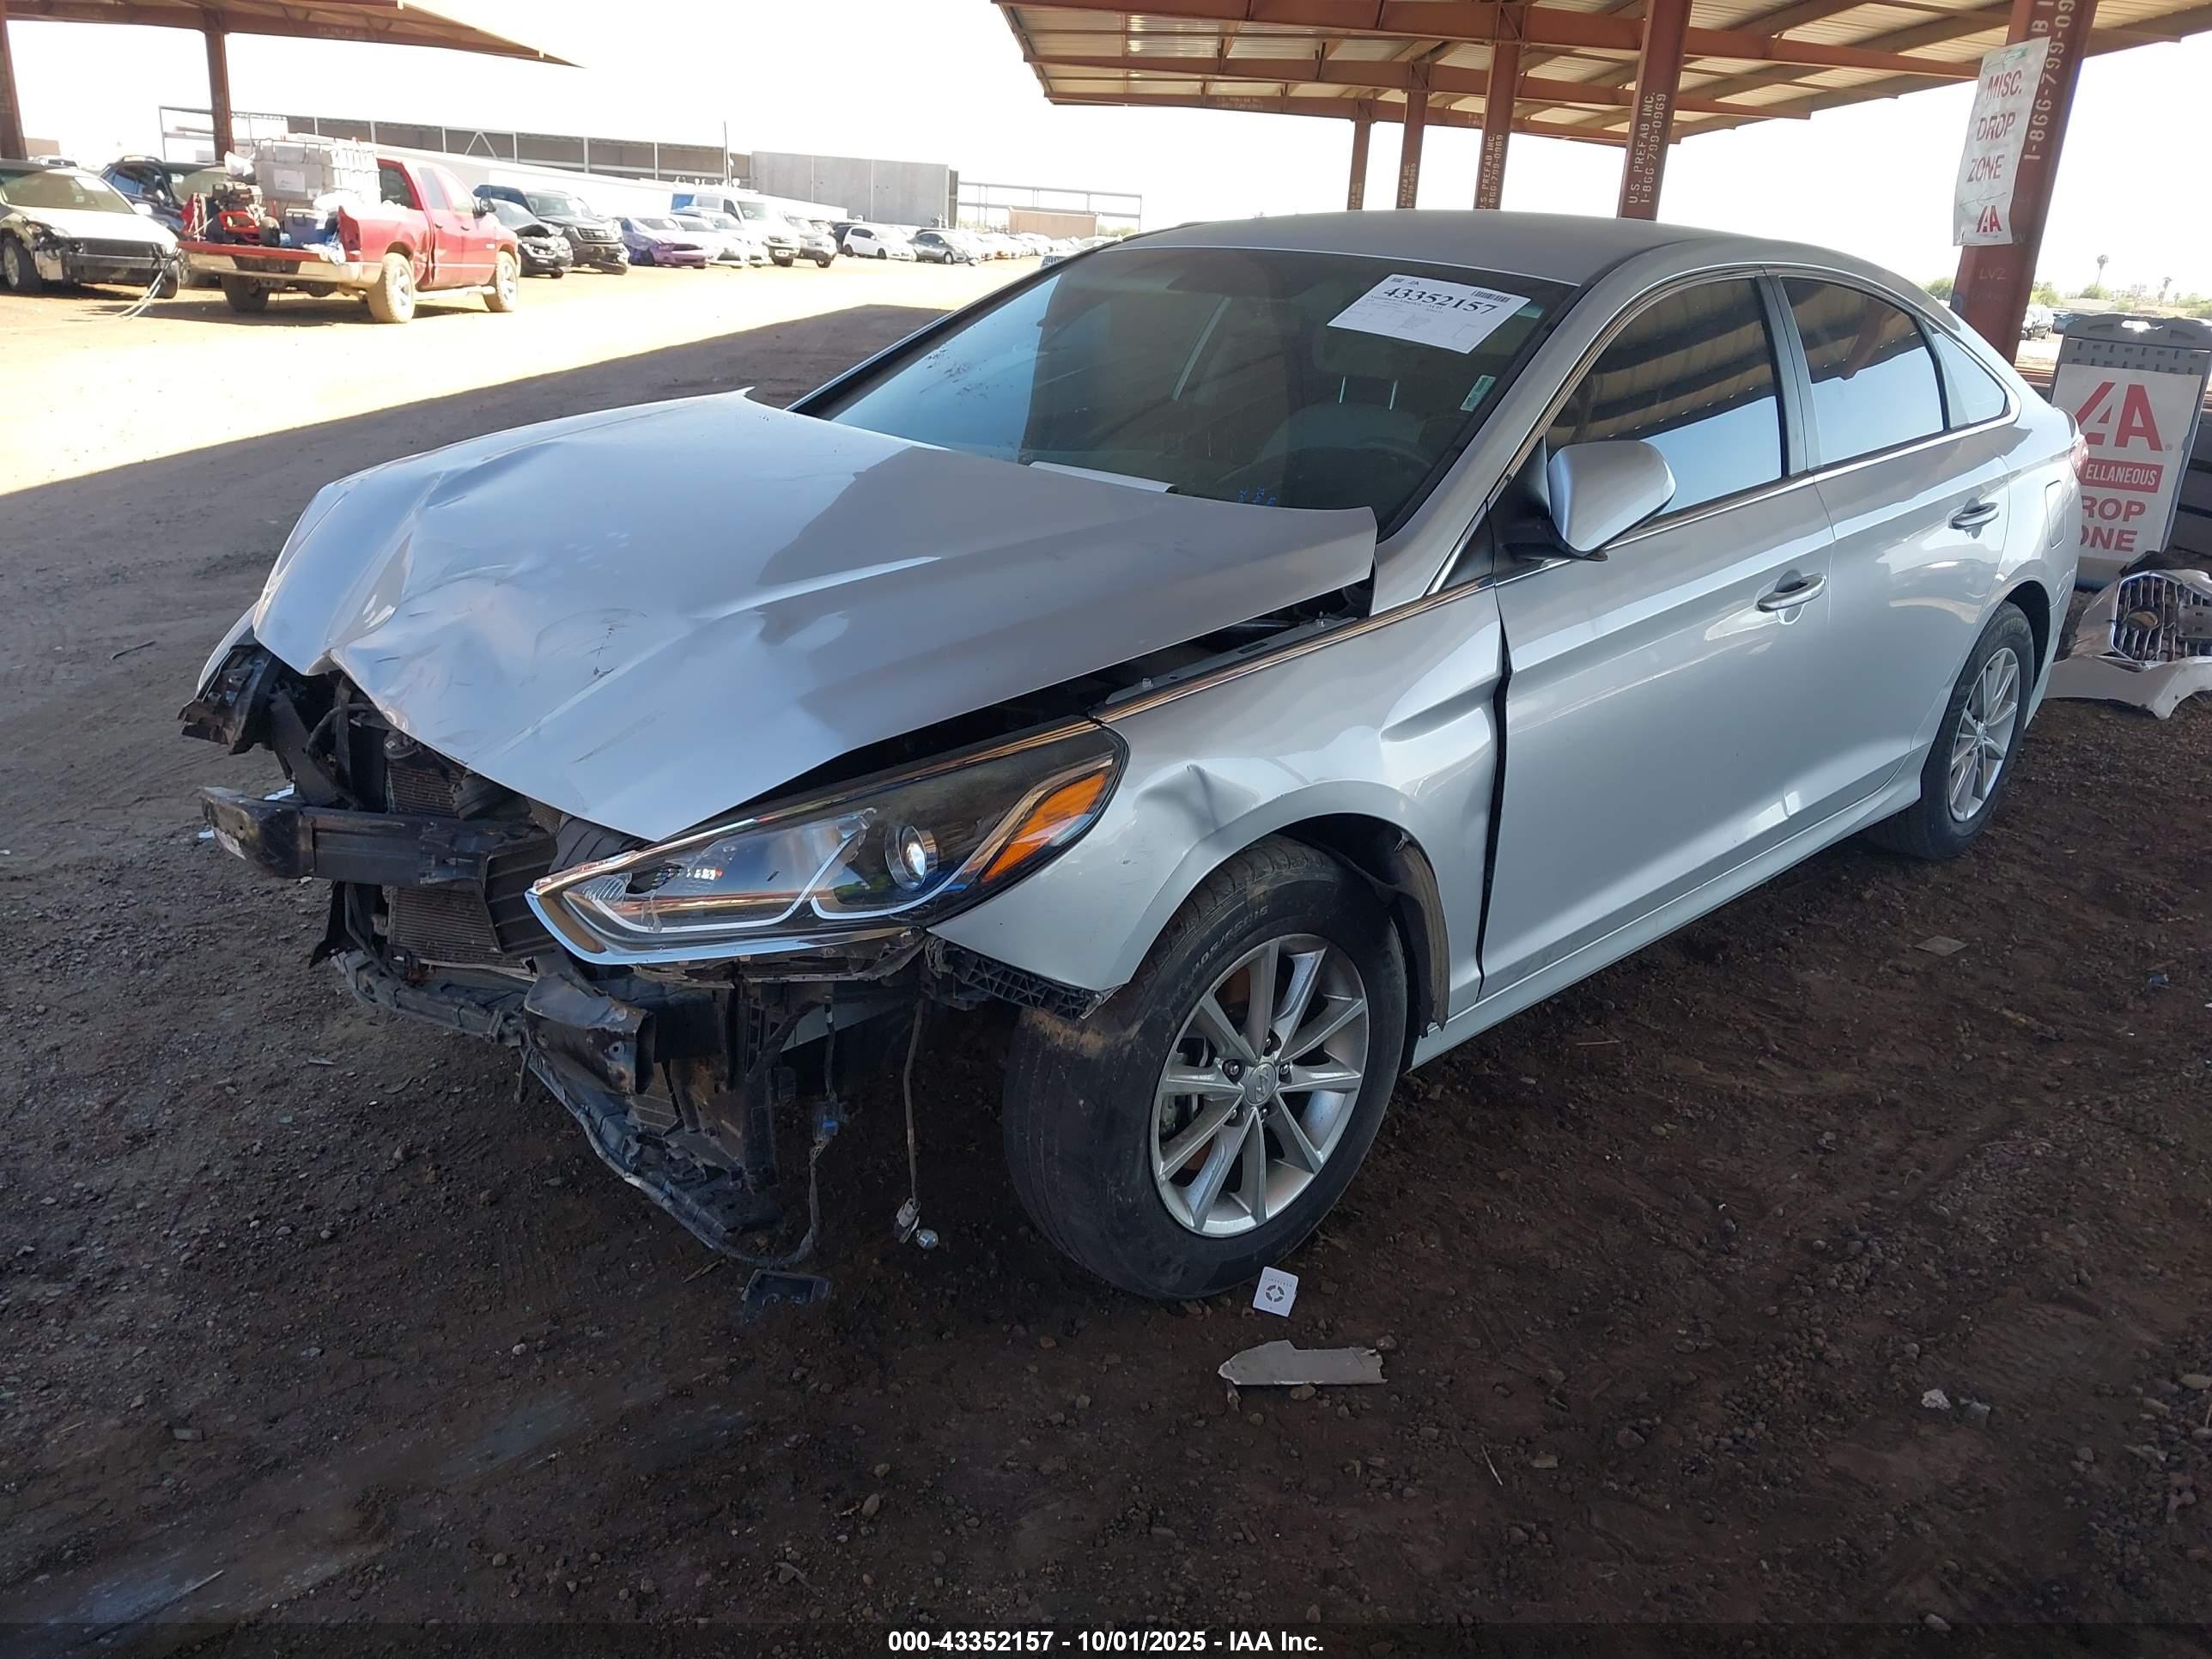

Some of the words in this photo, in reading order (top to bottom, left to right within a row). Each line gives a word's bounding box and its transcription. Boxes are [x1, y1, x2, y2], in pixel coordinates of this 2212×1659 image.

[1986, 70, 2022, 100] MISC.
[2024, 0, 2075, 161] 1-866-799-09
[1642, 92, 1656, 116] INC.
[1977, 112, 2016, 142] DROP
[1633, 123, 1650, 173] PREFAB
[1640, 94, 1667, 203] 1-866-799-0969
[1482, 155, 1493, 190] PREFAB
[1489, 134, 1504, 208] -866-799-0969
[1966, 154, 2005, 183] ZONE
[1628, 179, 1642, 204] U.S.
[1383, 287, 1498, 315] 43352157
[2085, 464, 2158, 486] ELLANEOUS
[2081, 495, 2146, 522] ROP
